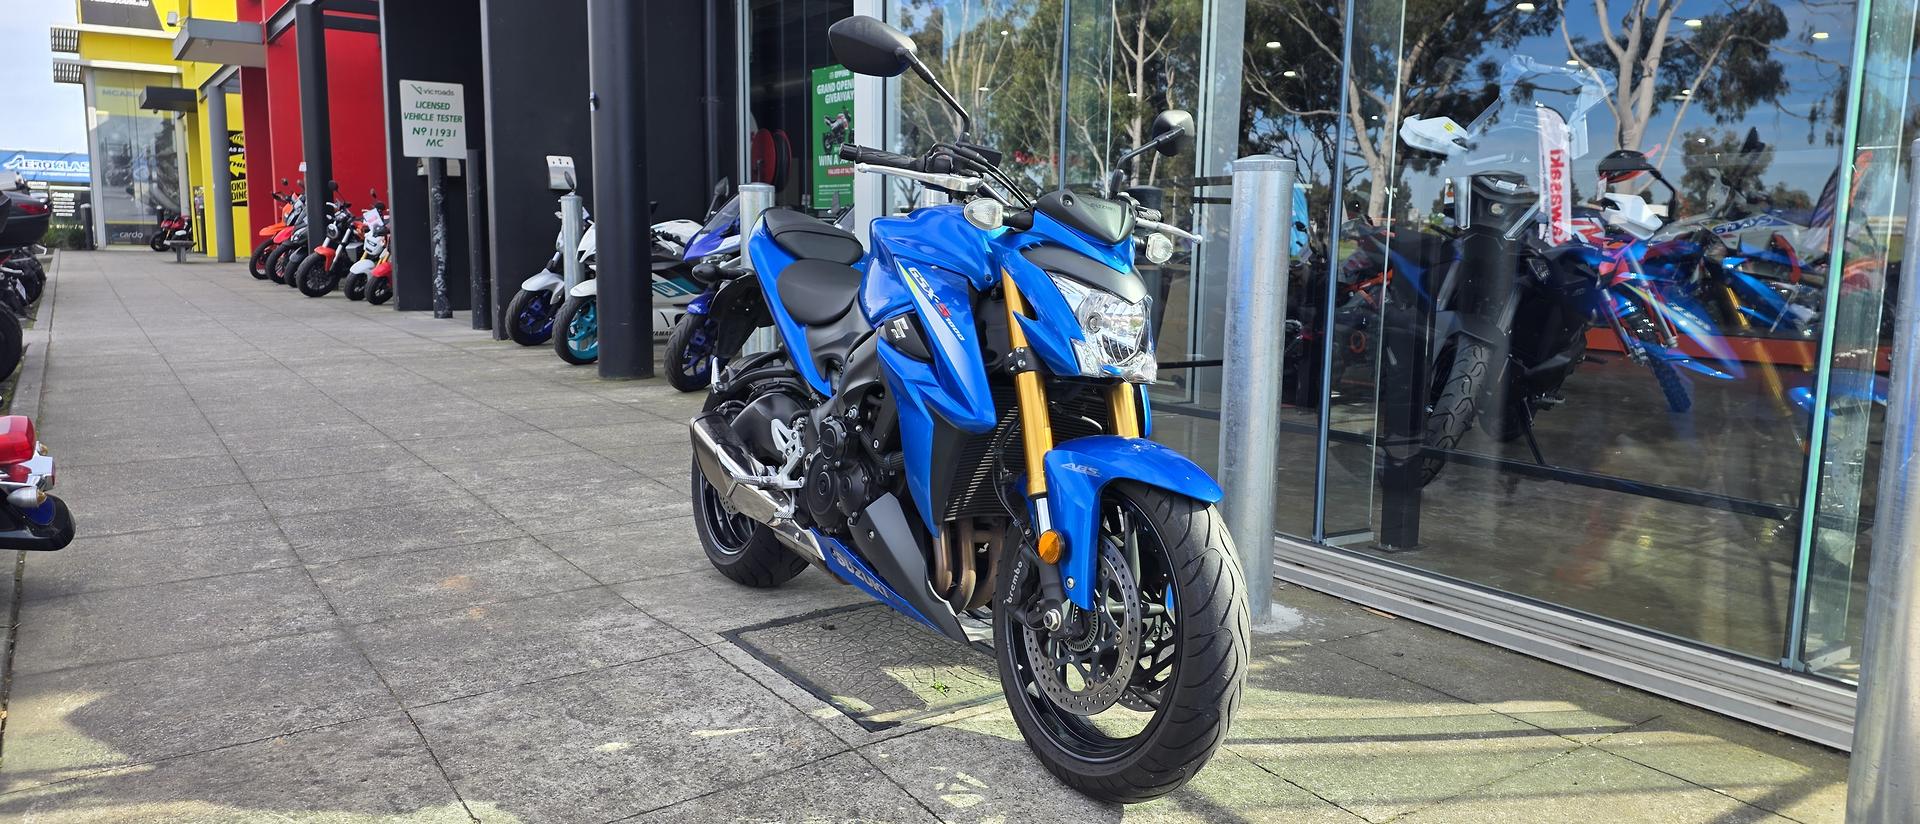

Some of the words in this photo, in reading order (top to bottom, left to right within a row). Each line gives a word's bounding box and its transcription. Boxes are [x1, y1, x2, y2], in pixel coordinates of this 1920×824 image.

[816, 82, 836, 95] GRAND
[415, 101, 451, 110] LICENSED
[404, 112, 434, 121] VEHICLE
[437, 114, 463, 123] TESTER
[429, 128, 456, 137] 11931
[425, 138, 444, 147] MC
[818, 154, 833, 167] WIN
[119, 231, 144, 239] cardo
[1060, 462, 1101, 478] ABS
[834, 550, 890, 599] SUZUKI
[1006, 561, 1023, 604] brembo
